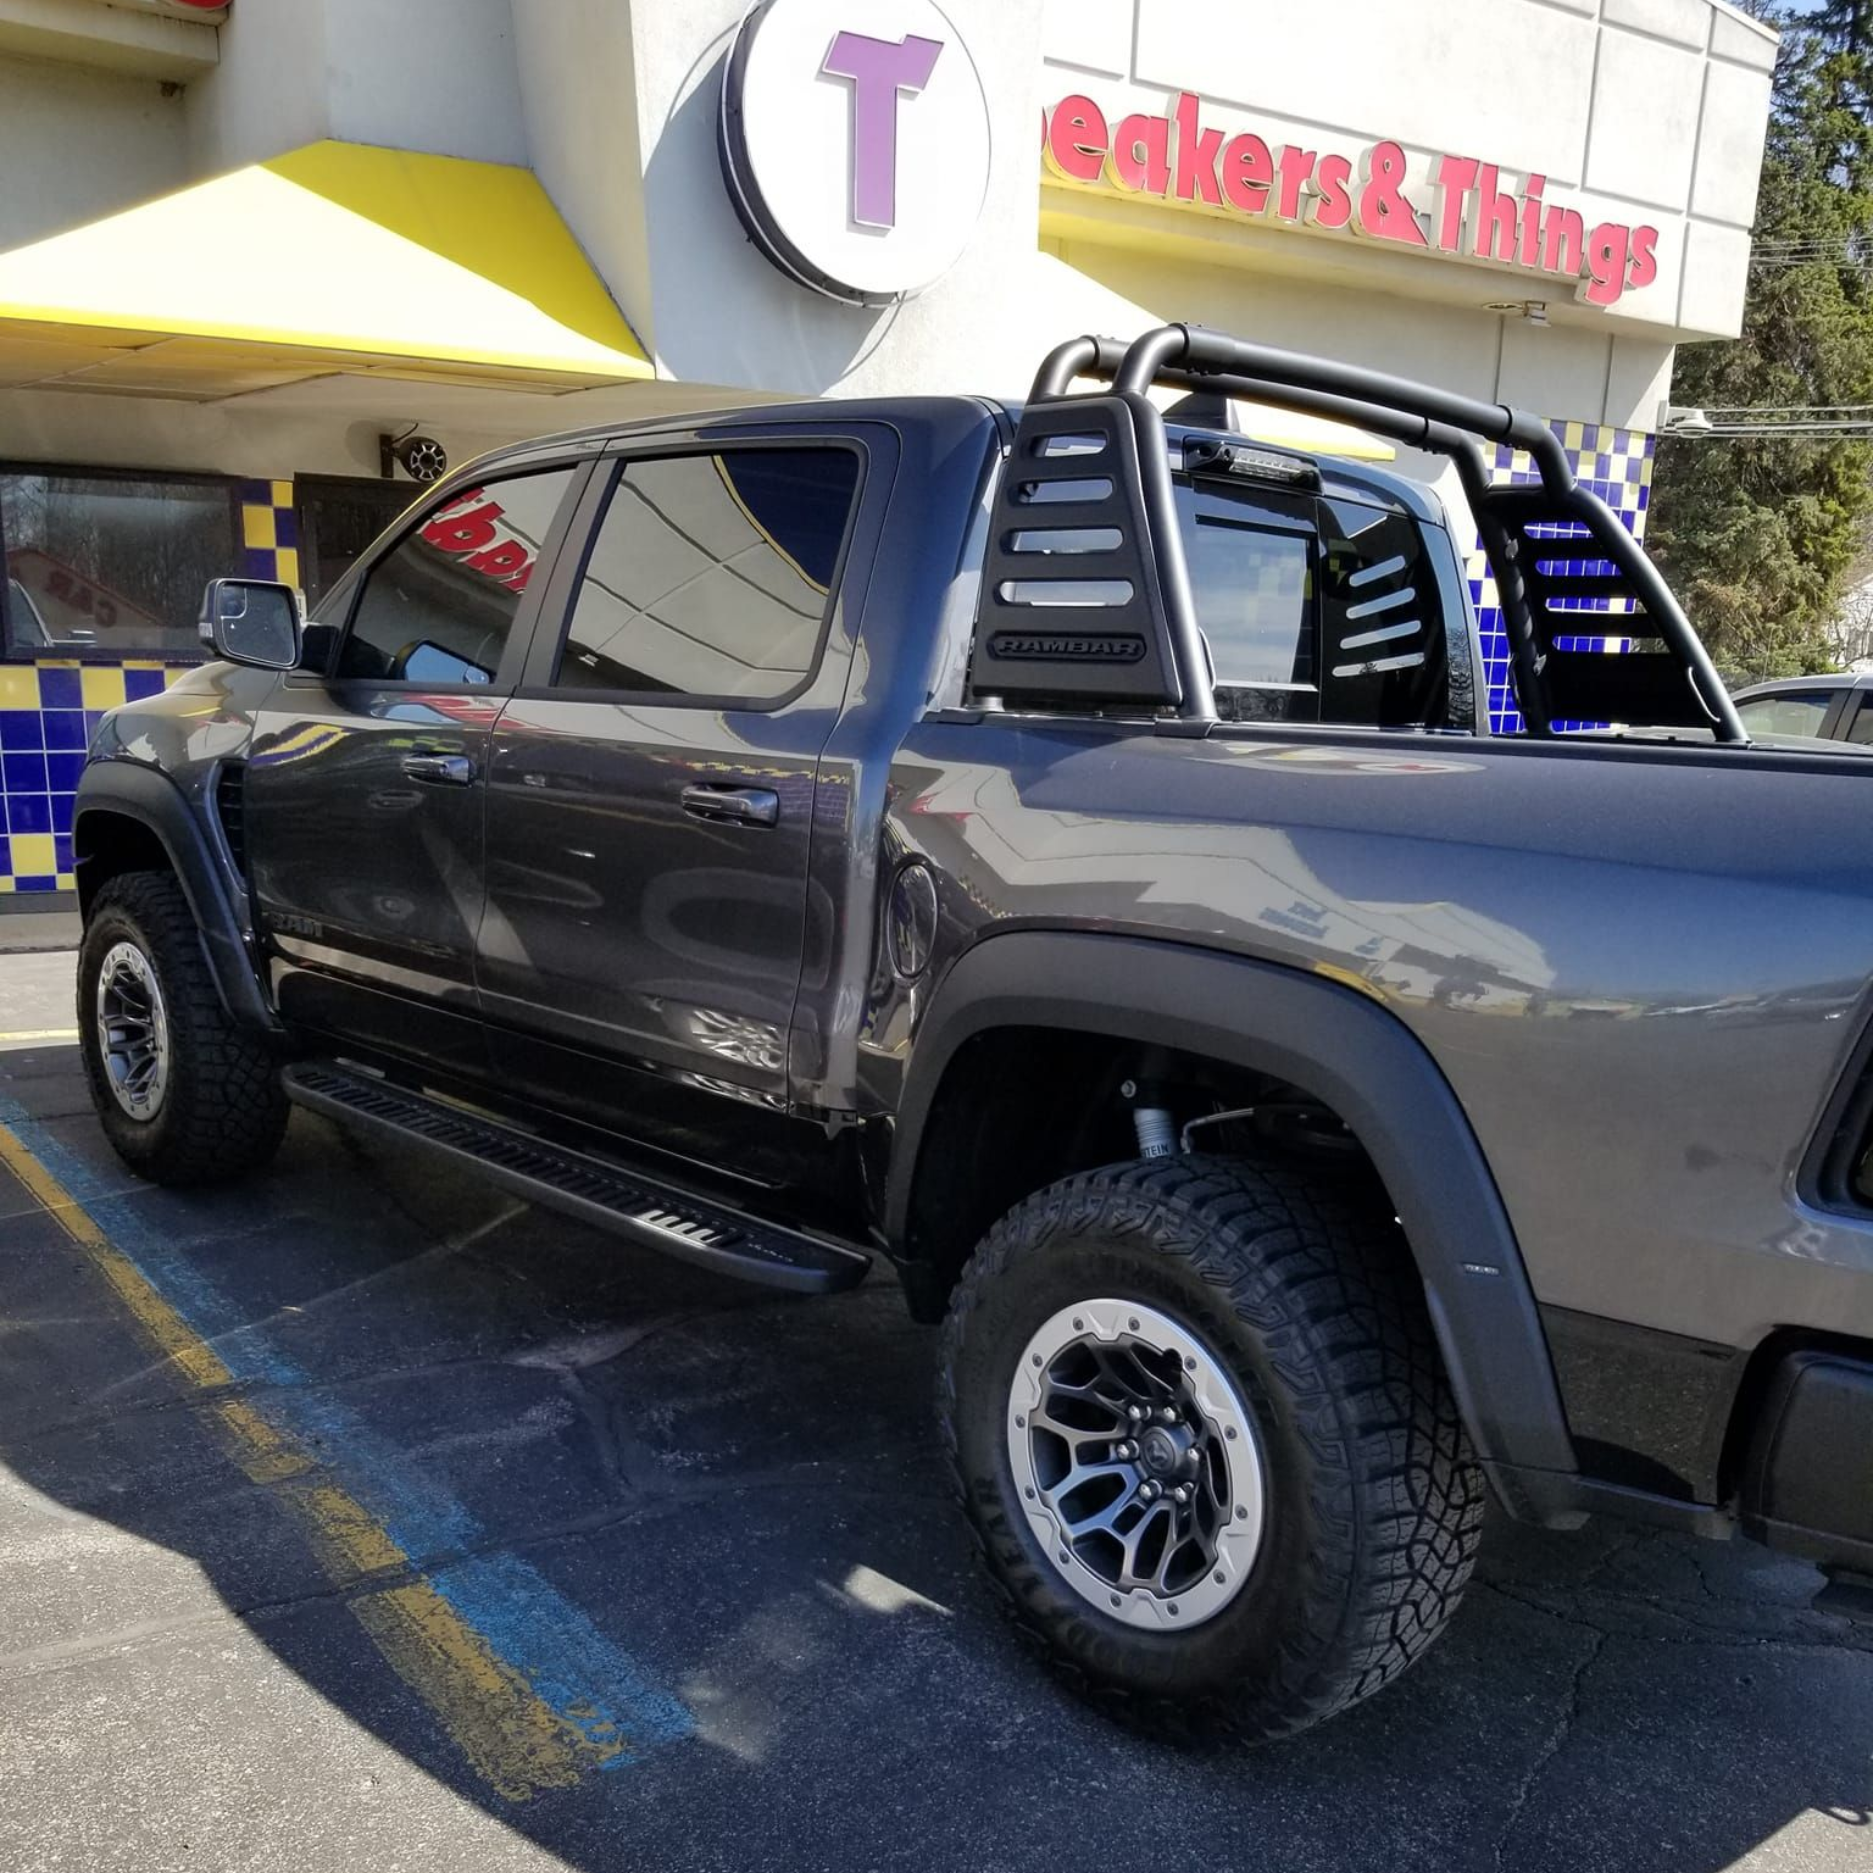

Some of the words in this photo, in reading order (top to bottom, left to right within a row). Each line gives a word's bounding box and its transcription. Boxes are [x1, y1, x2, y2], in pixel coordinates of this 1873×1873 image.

[820, 30, 945, 229] T
[1041, 91, 1353, 229] eakers
[999, 639, 1139, 656] RAMBAR
